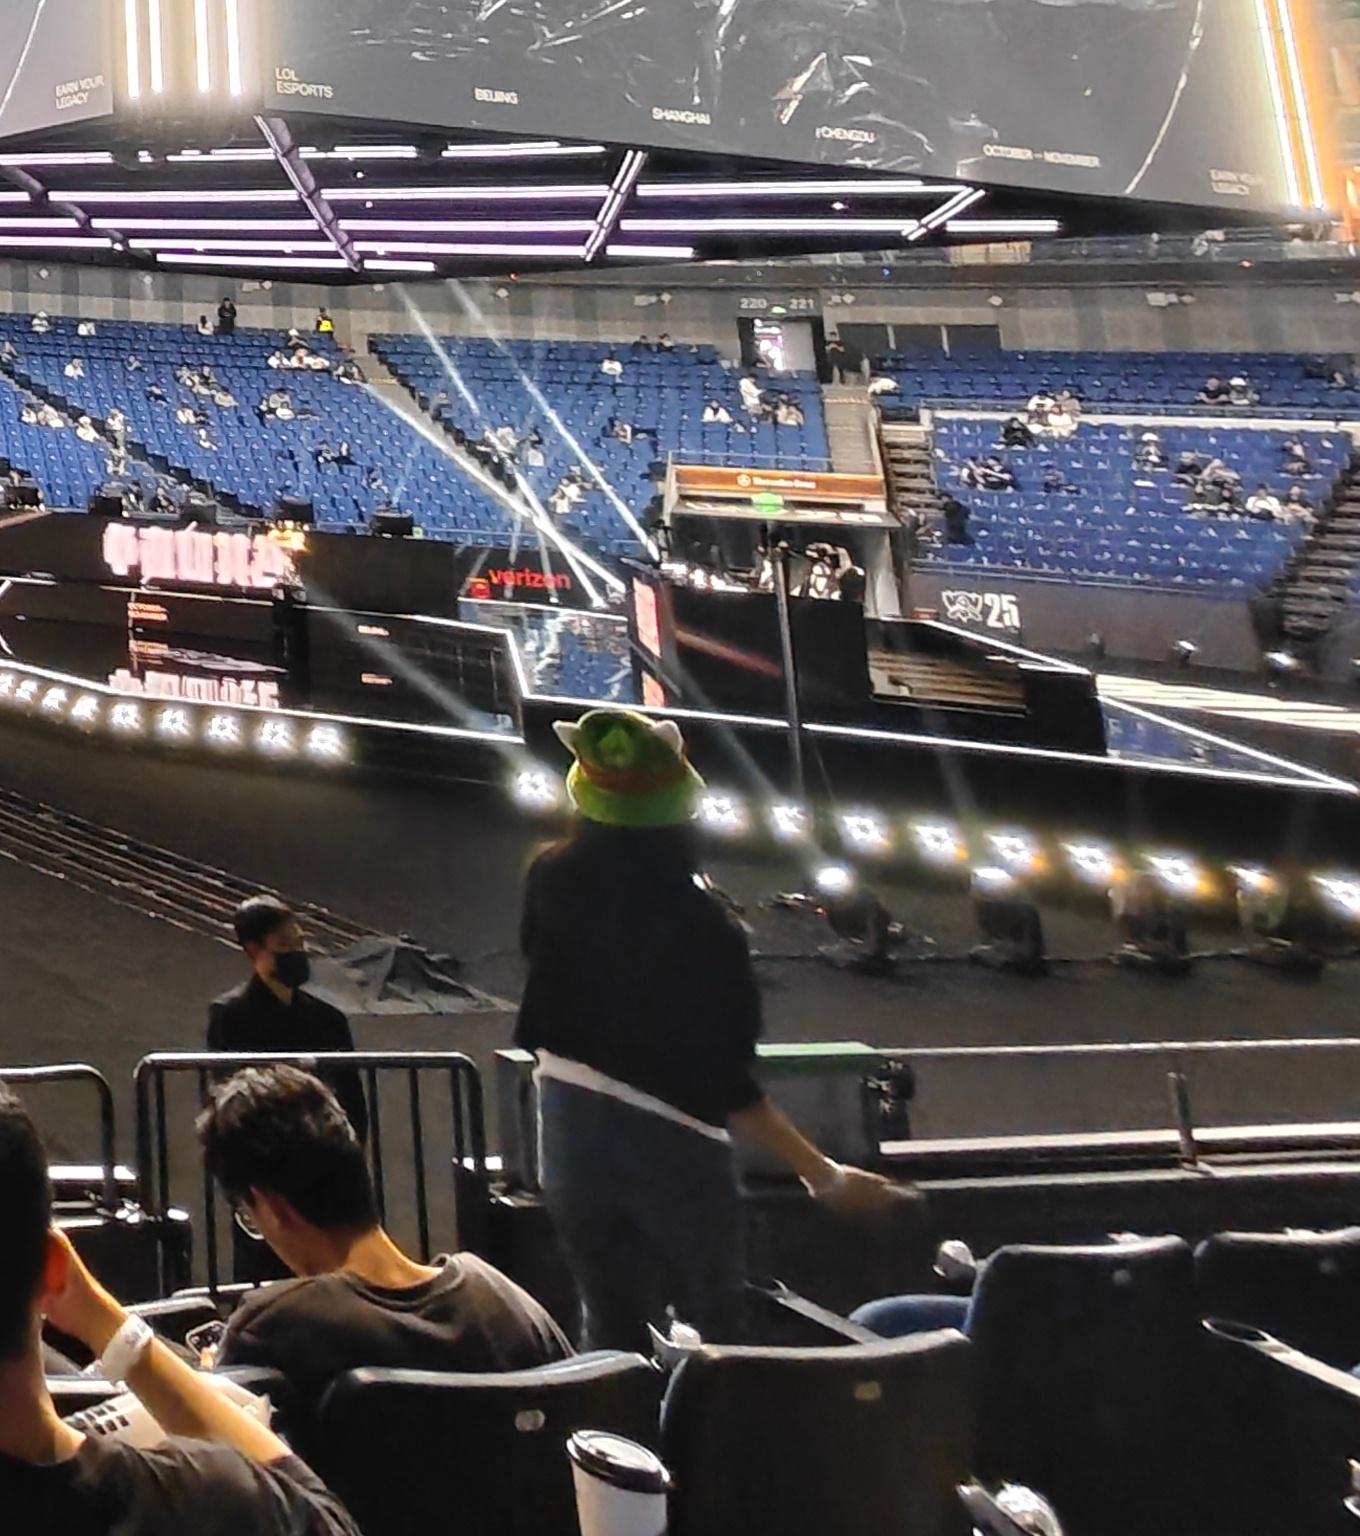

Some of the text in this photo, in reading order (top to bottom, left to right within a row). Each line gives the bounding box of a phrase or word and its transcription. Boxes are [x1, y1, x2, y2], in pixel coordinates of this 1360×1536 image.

[276, 68, 299, 81] LOL
[55, 82, 79, 98] EARN
[276, 82, 335, 100] ESPORTS
[474, 87, 519, 105] BEIJING
[651, 106, 711, 125] SHANGHAI
[740, 297, 766, 310] 220
[488, 568, 573, 590] verizon
[983, 593, 1021, 629] 25
